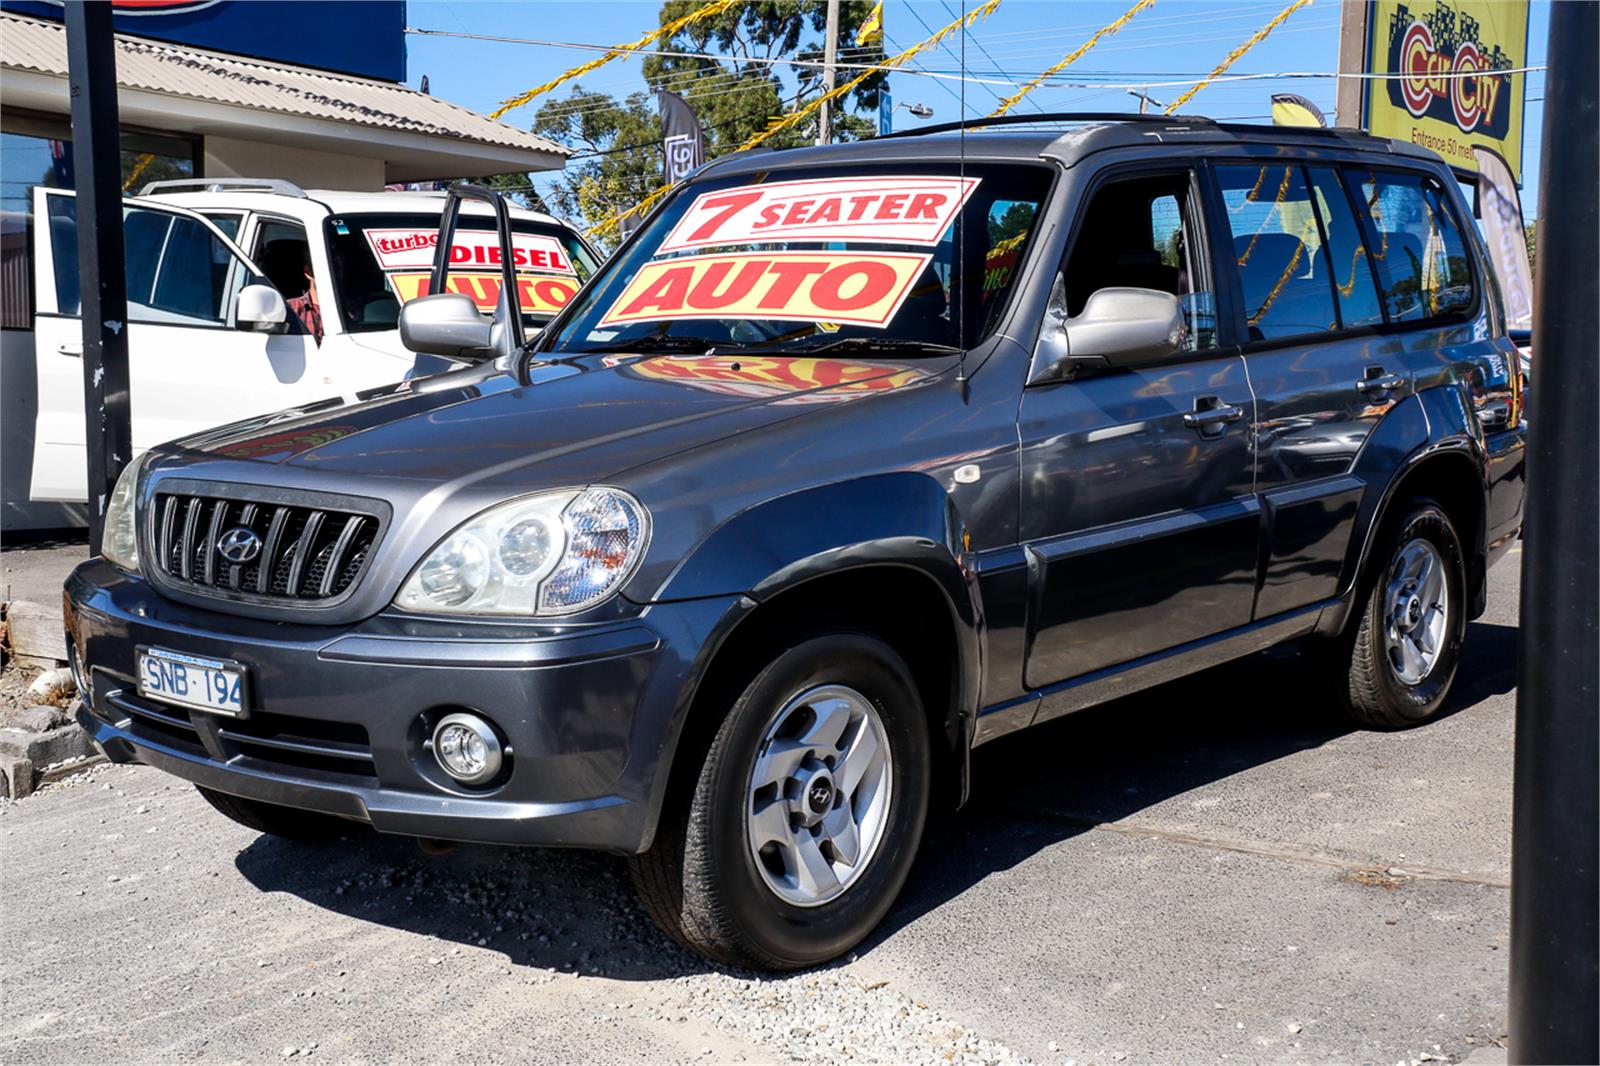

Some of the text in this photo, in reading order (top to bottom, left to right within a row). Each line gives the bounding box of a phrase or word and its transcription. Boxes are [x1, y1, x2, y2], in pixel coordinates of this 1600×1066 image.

[1400, 20, 1502, 133] Car City
[1411, 127, 1446, 153] Entrance
[1447, 138, 1458, 156] 50
[687, 191, 937, 242] 7 SEATER
[378, 233, 439, 252] turbo
[449, 245, 567, 270] DIESEL
[619, 260, 898, 315] AUTO
